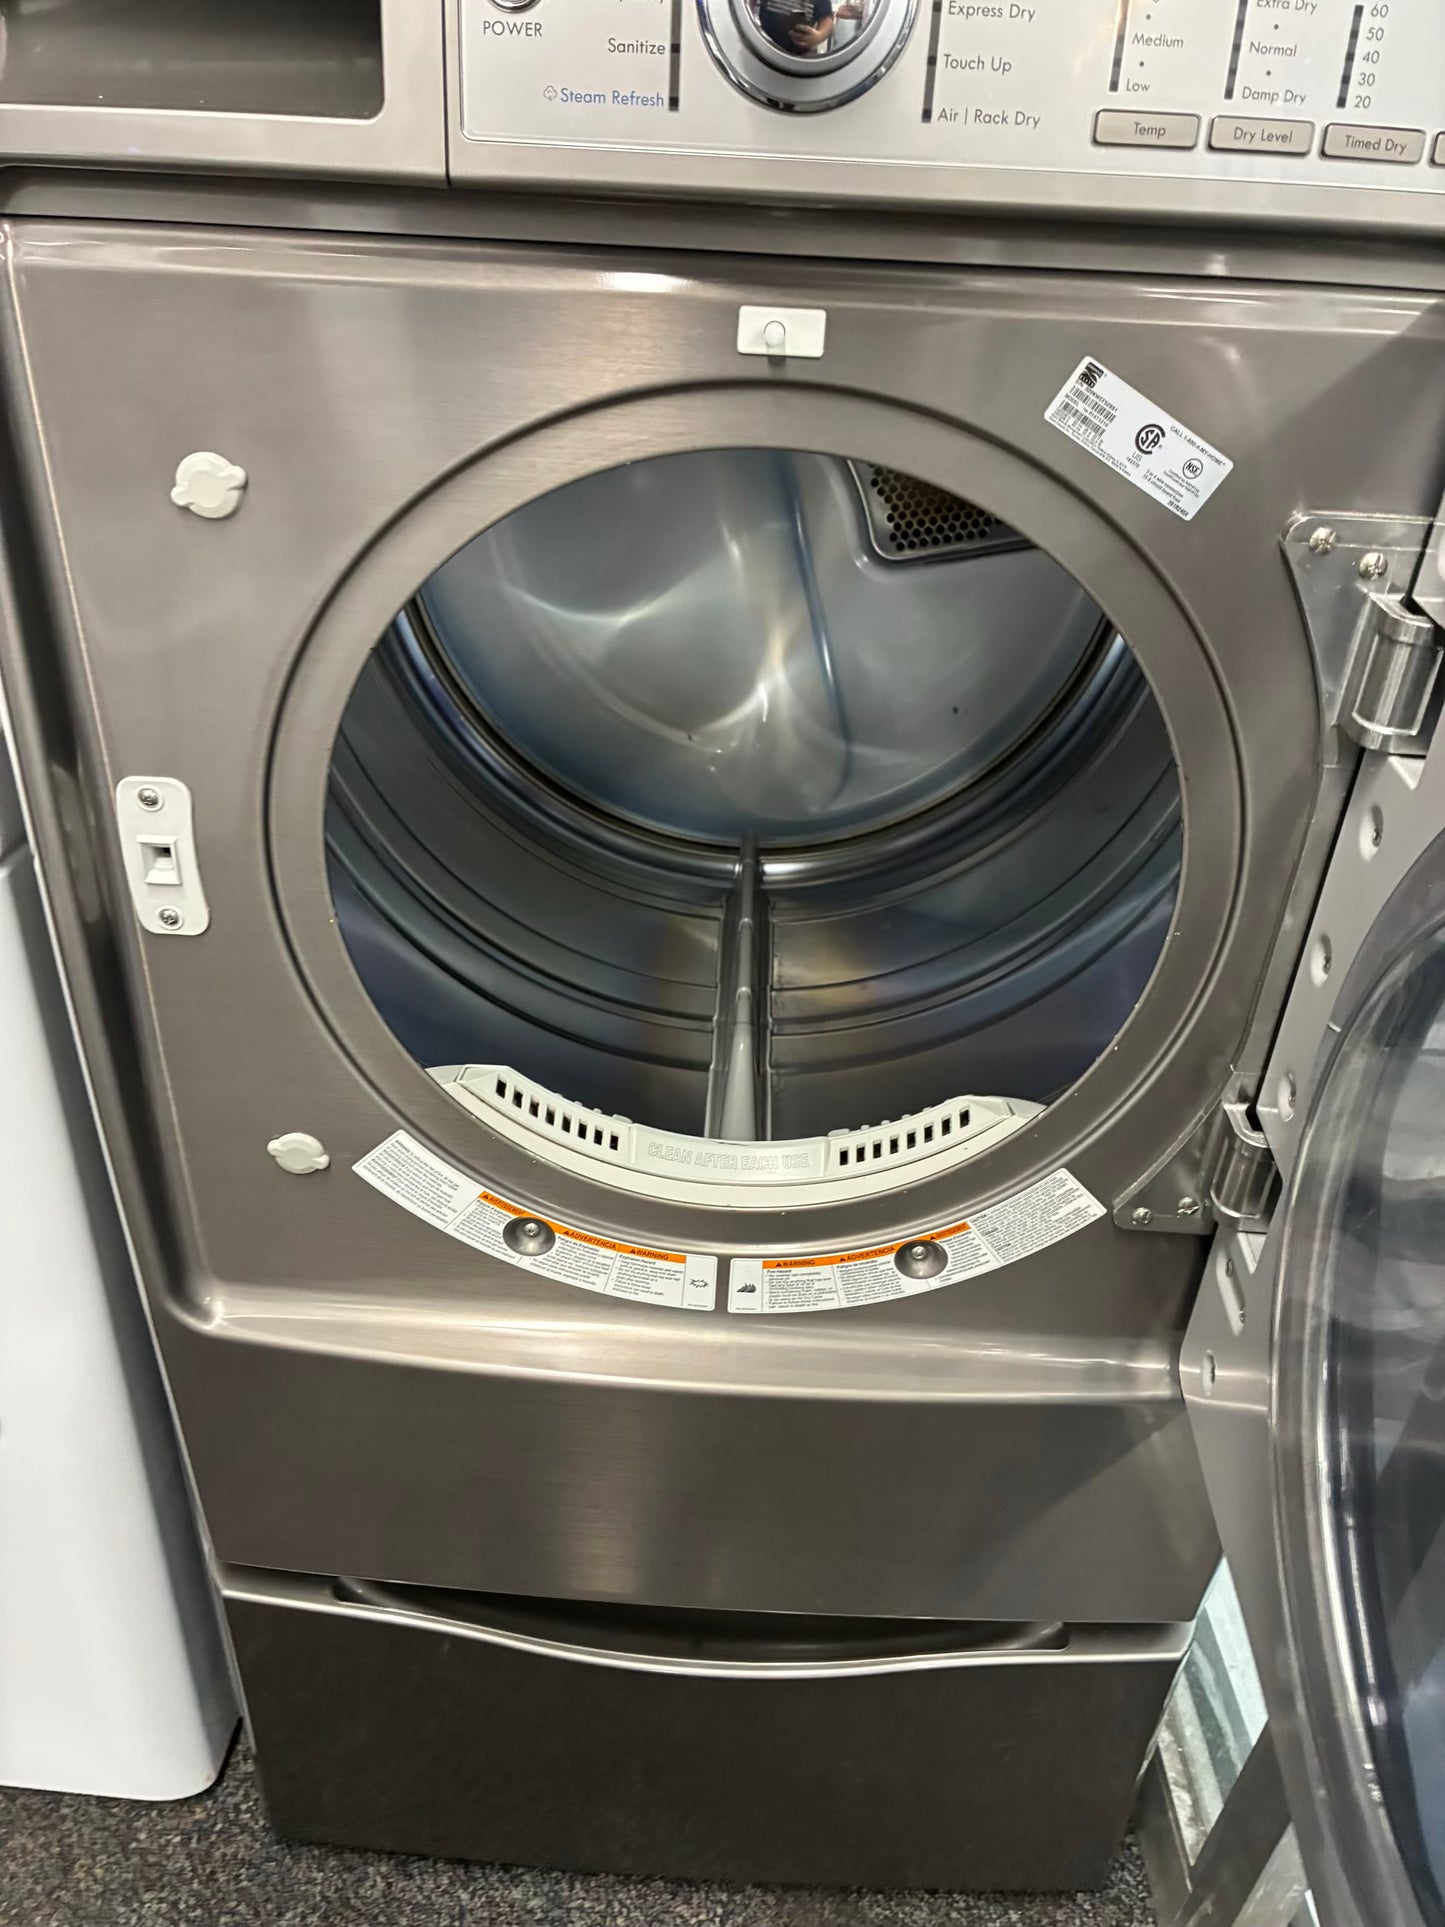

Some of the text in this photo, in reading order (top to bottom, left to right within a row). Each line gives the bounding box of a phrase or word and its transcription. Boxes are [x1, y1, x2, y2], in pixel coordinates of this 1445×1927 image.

[948, 0, 1036, 22] Express Dry
[1295, 0, 1317, 14] Dry
[1370, 4, 1389, 18] 60
[483, 20, 542, 37] POWER
[1366, 27, 1385, 41] 50
[607, 37, 666, 55] Sanitize
[1132, 33, 1184, 48] Medium
[1249, 41, 1298, 57] Normal
[943, 53, 1012, 75] Touch Up
[1362, 50, 1381, 64] 40
[1126, 79, 1150, 92] Low
[1358, 73, 1376, 86] 30
[560, 88, 664, 106] Steam Refresh
[1241, 86, 1307, 104] Damp Dry
[1354, 95, 1372, 109] 20
[937, 107, 959, 122] Air
[974, 108, 1009, 125] Rack
[1014, 110, 1041, 129] Dry
[1134, 122, 1166, 140] Temp
[1233, 126, 1293, 143] Dry Level
[1345, 135, 1407, 155] Timed Dry
[648, 1141, 809, 1170] CLEAN AFTER EACH USE
[569, 1232, 616, 1250] ADVERTENCIA
[636, 1249, 669, 1261] WARNING
